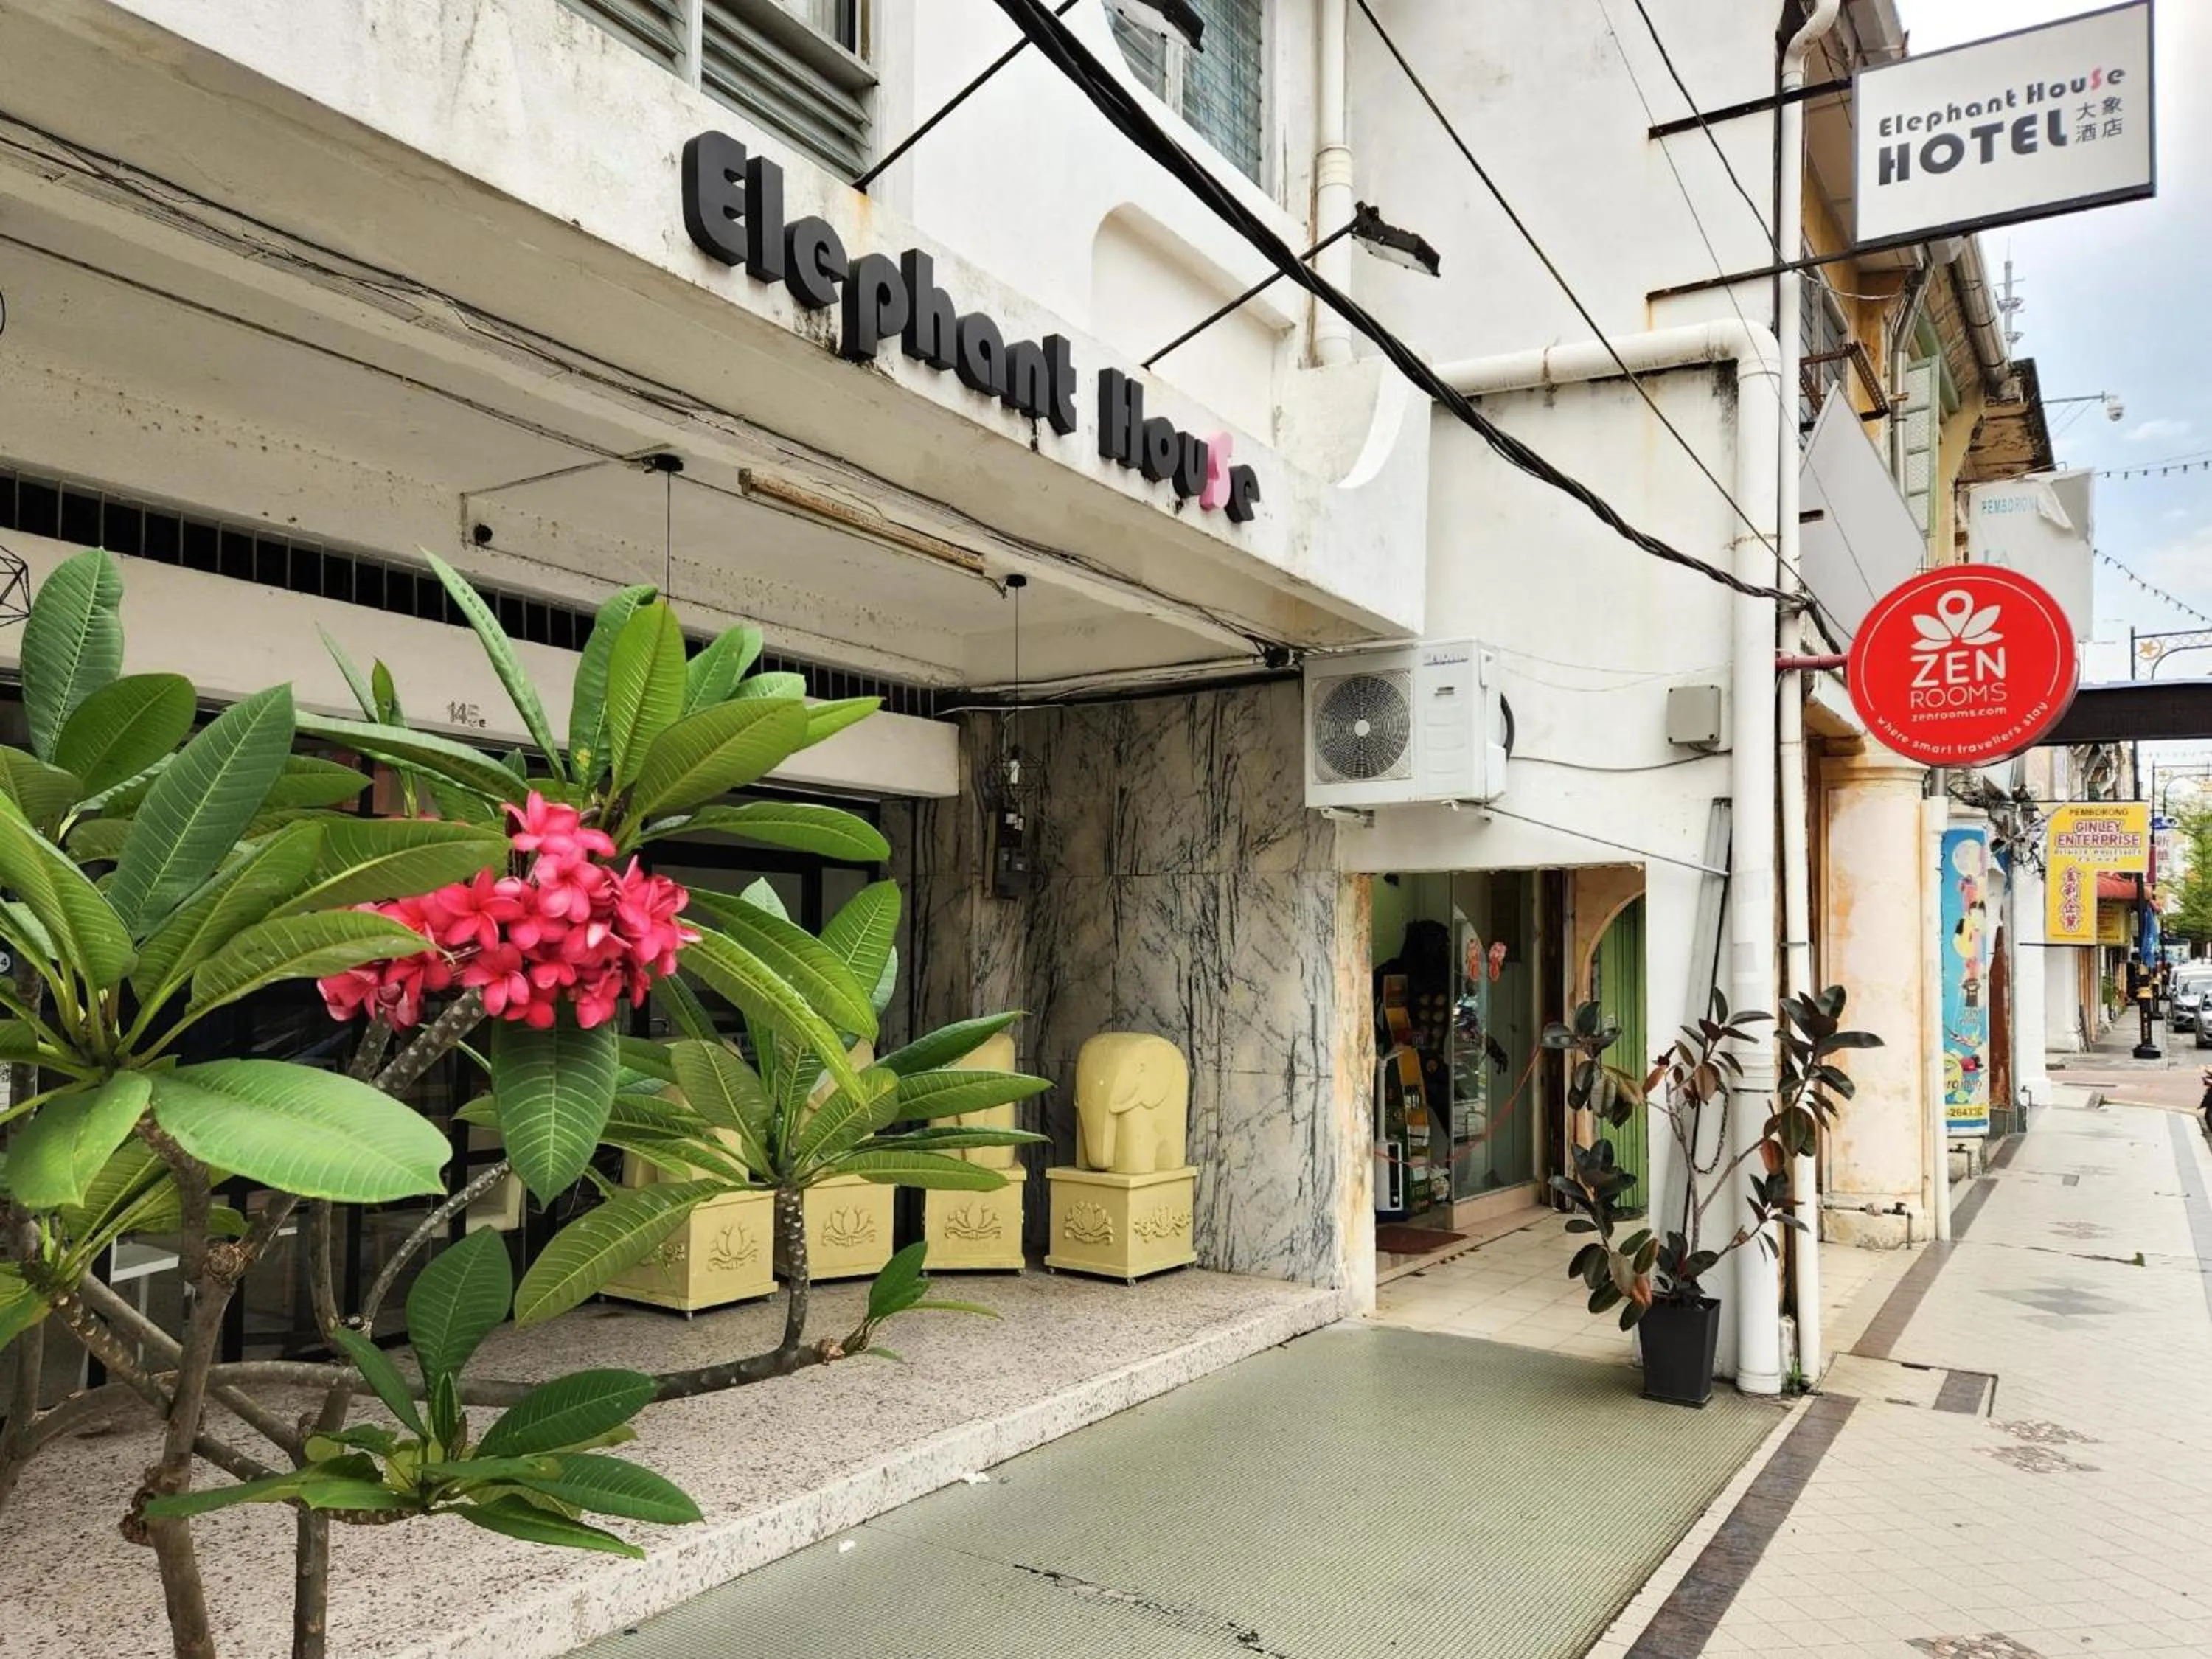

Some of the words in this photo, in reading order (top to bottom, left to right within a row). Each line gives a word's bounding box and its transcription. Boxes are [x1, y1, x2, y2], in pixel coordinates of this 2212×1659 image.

[1879, 89, 2016, 137] Elephant
[2027, 66, 2126, 105] House
[2076, 96, 2123, 121] 大象
[2076, 118, 2123, 144] 酒店
[1879, 108, 2067, 186] HOTEL
[682, 130, 1077, 435] Elephant
[1099, 367, 1261, 524] House
[1910, 647, 2006, 688] ZEN
[1910, 682, 2008, 709] ROOMS
[1877, 714, 1910, 743] where
[1912, 740, 1953, 754] smart
[1958, 726, 2022, 754] travellers
[2023, 701, 2048, 726] stay
[1911, 706, 2006, 722] zenrooms.com
[2069, 807, 2129, 816] PEMBORONG
[2057, 834, 2140, 846] ENTERPRISE
